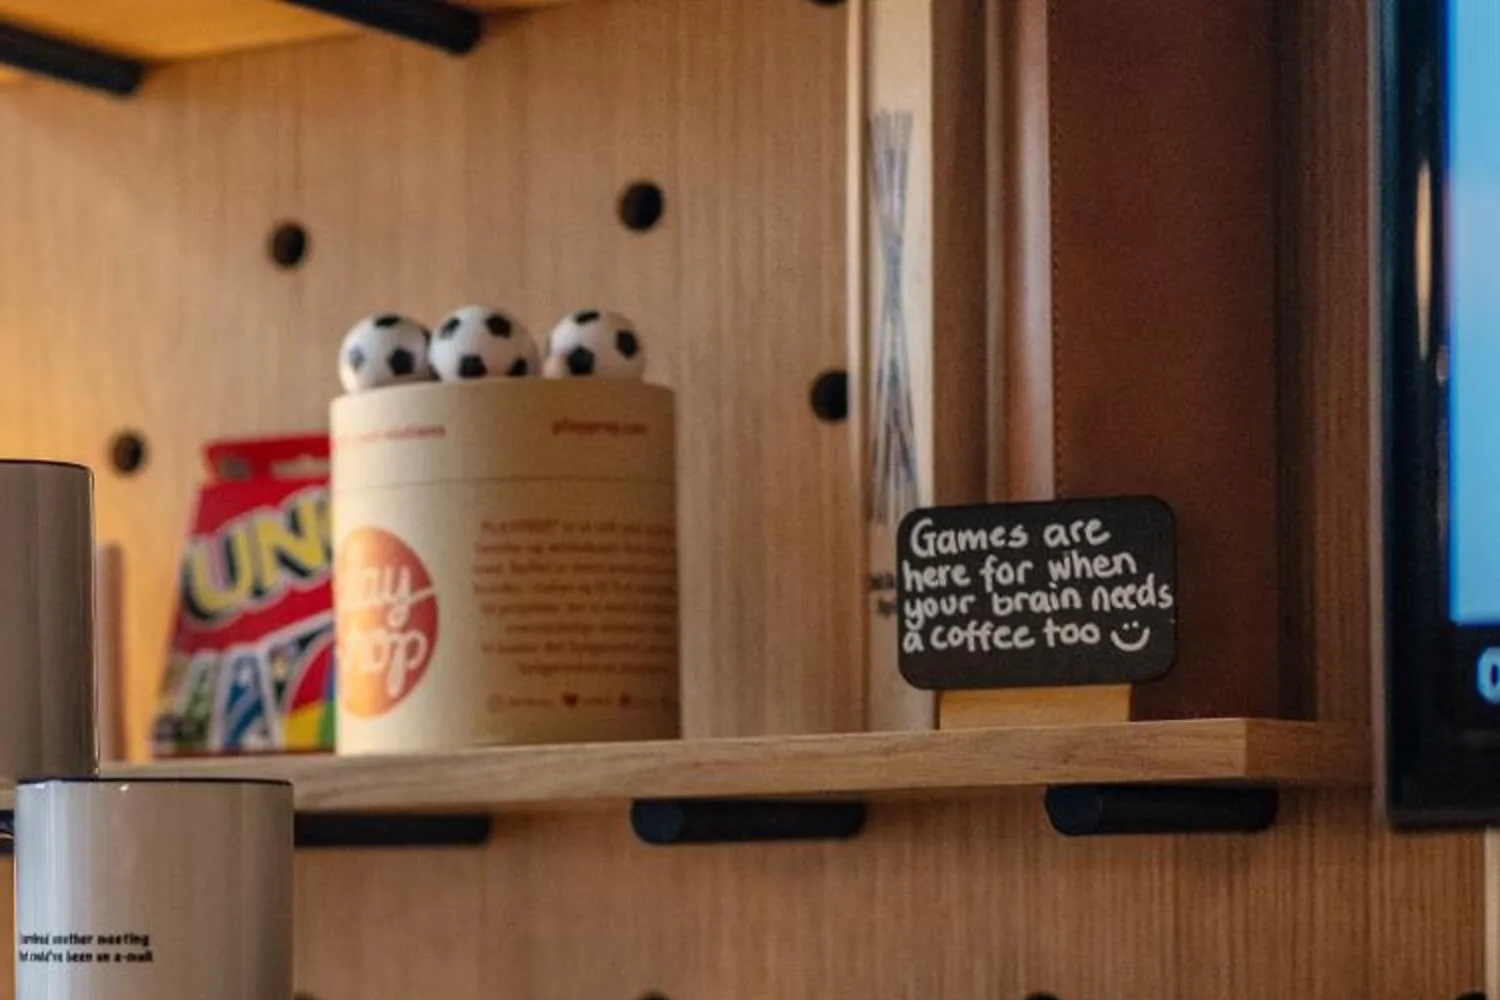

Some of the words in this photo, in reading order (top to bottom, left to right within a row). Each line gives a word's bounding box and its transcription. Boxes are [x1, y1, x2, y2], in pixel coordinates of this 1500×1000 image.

[185, 497, 333, 618] UN
[910, 517, 1029, 559] Games
[1043, 518, 1111, 549] are
[902, 558, 971, 592] here
[979, 554, 1033, 593] for
[1048, 551, 1137, 582] when
[903, 593, 976, 632] your
[992, 582, 1082, 617] brain
[1091, 573, 1173, 612] needs
[902, 631, 924, 653] a
[930, 620, 1036, 653] coffee
[1043, 618, 1101, 647] too
[66, 951, 92, 962] been
[97, 953, 110, 962] an
[97, 933, 149, 946] meeting
